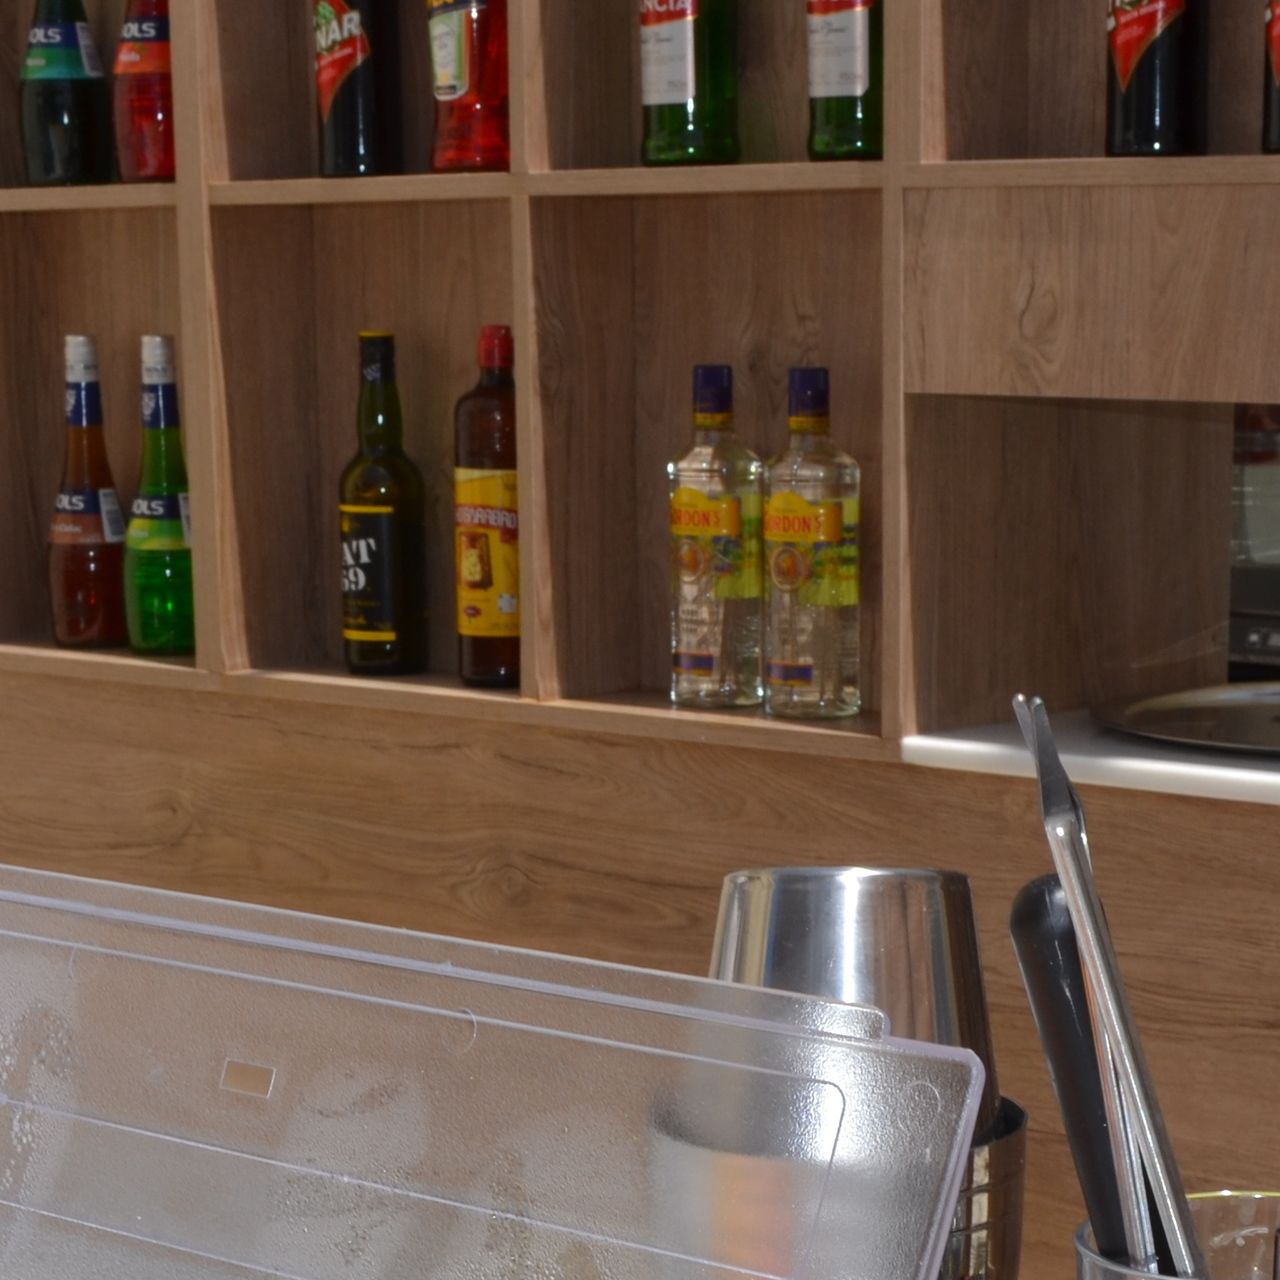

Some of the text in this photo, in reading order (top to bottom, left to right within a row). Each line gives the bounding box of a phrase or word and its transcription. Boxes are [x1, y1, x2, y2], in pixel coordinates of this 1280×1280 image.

[28, 27, 63, 44] OLS
[121, 21, 158, 39] OLS
[55, 494, 86, 512] OLS
[131, 499, 166, 516] OLS
[342, 537, 377, 567] AT
